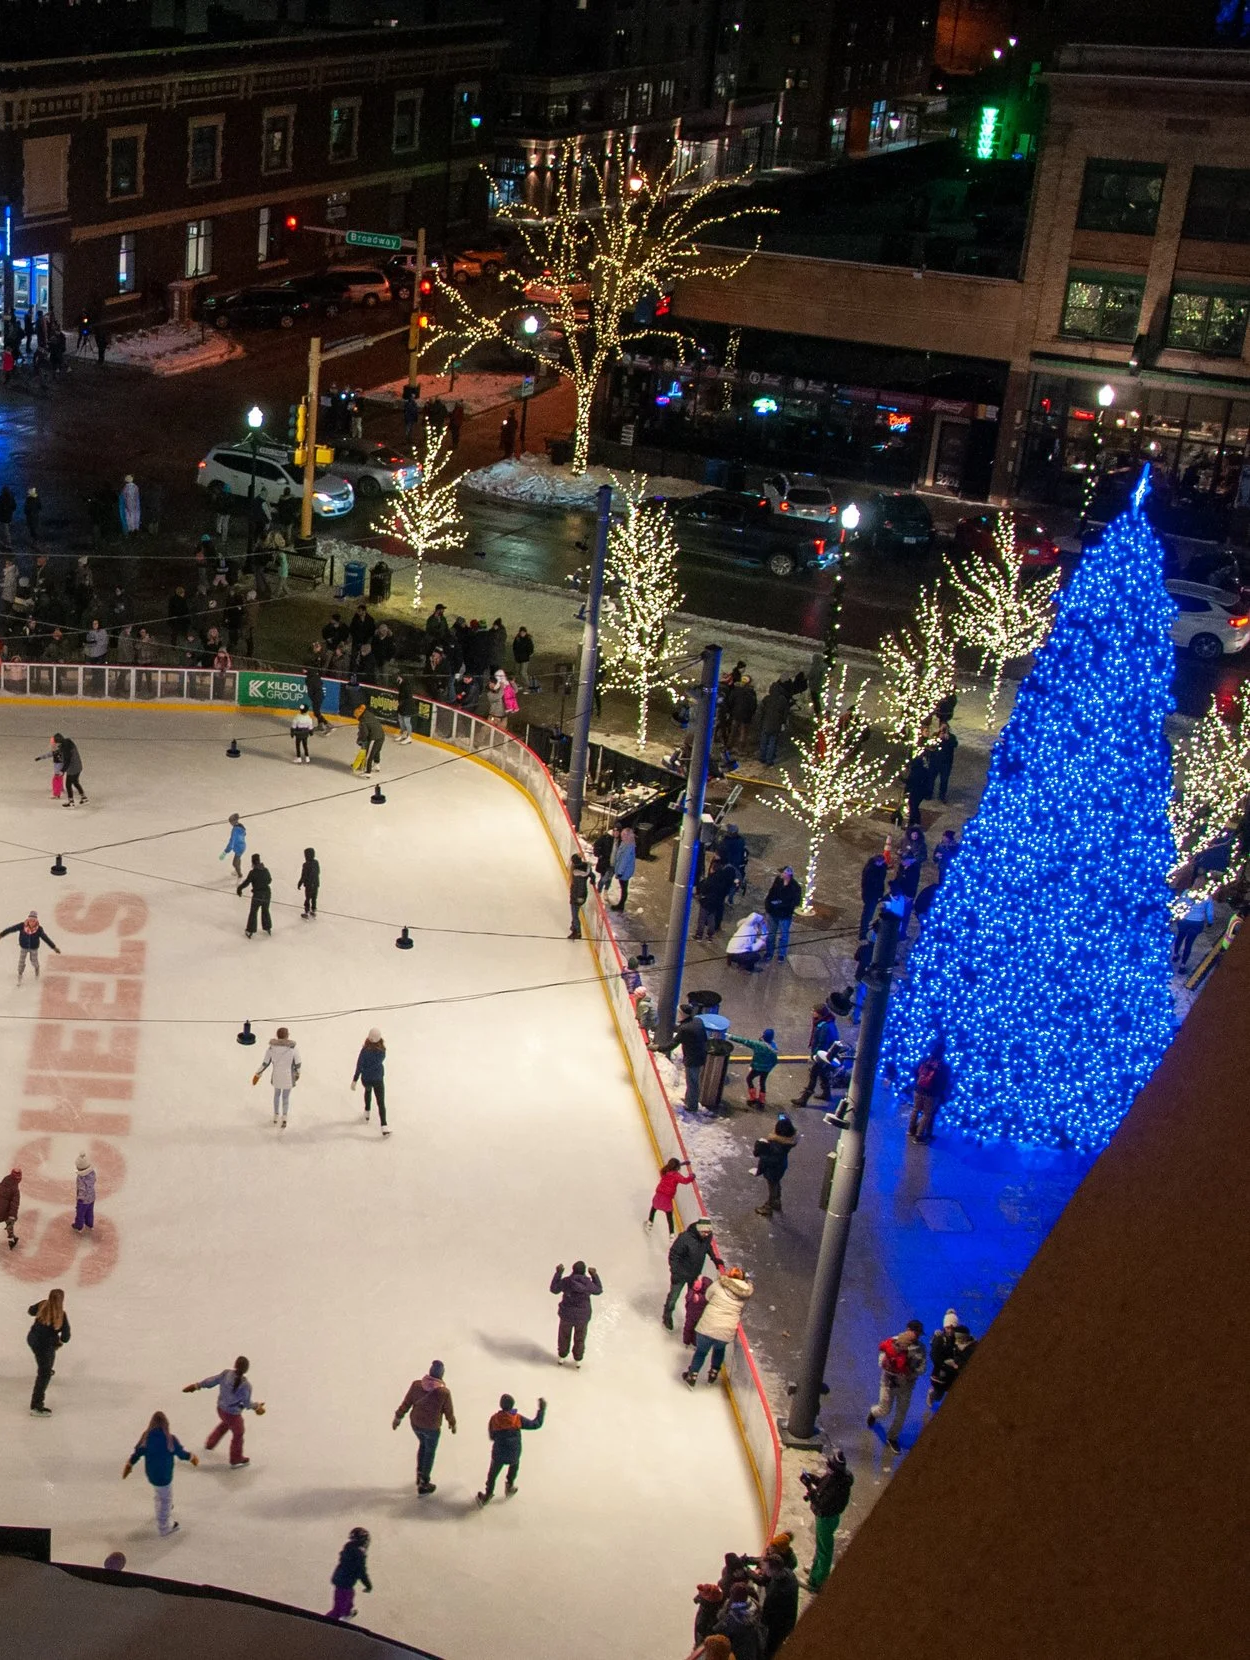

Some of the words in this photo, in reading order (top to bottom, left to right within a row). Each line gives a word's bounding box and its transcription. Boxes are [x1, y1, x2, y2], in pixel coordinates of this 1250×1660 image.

[350, 232, 397, 249] Broadway
[266, 690, 304, 701] GROUP
[267, 681, 326, 696] KILBOU
